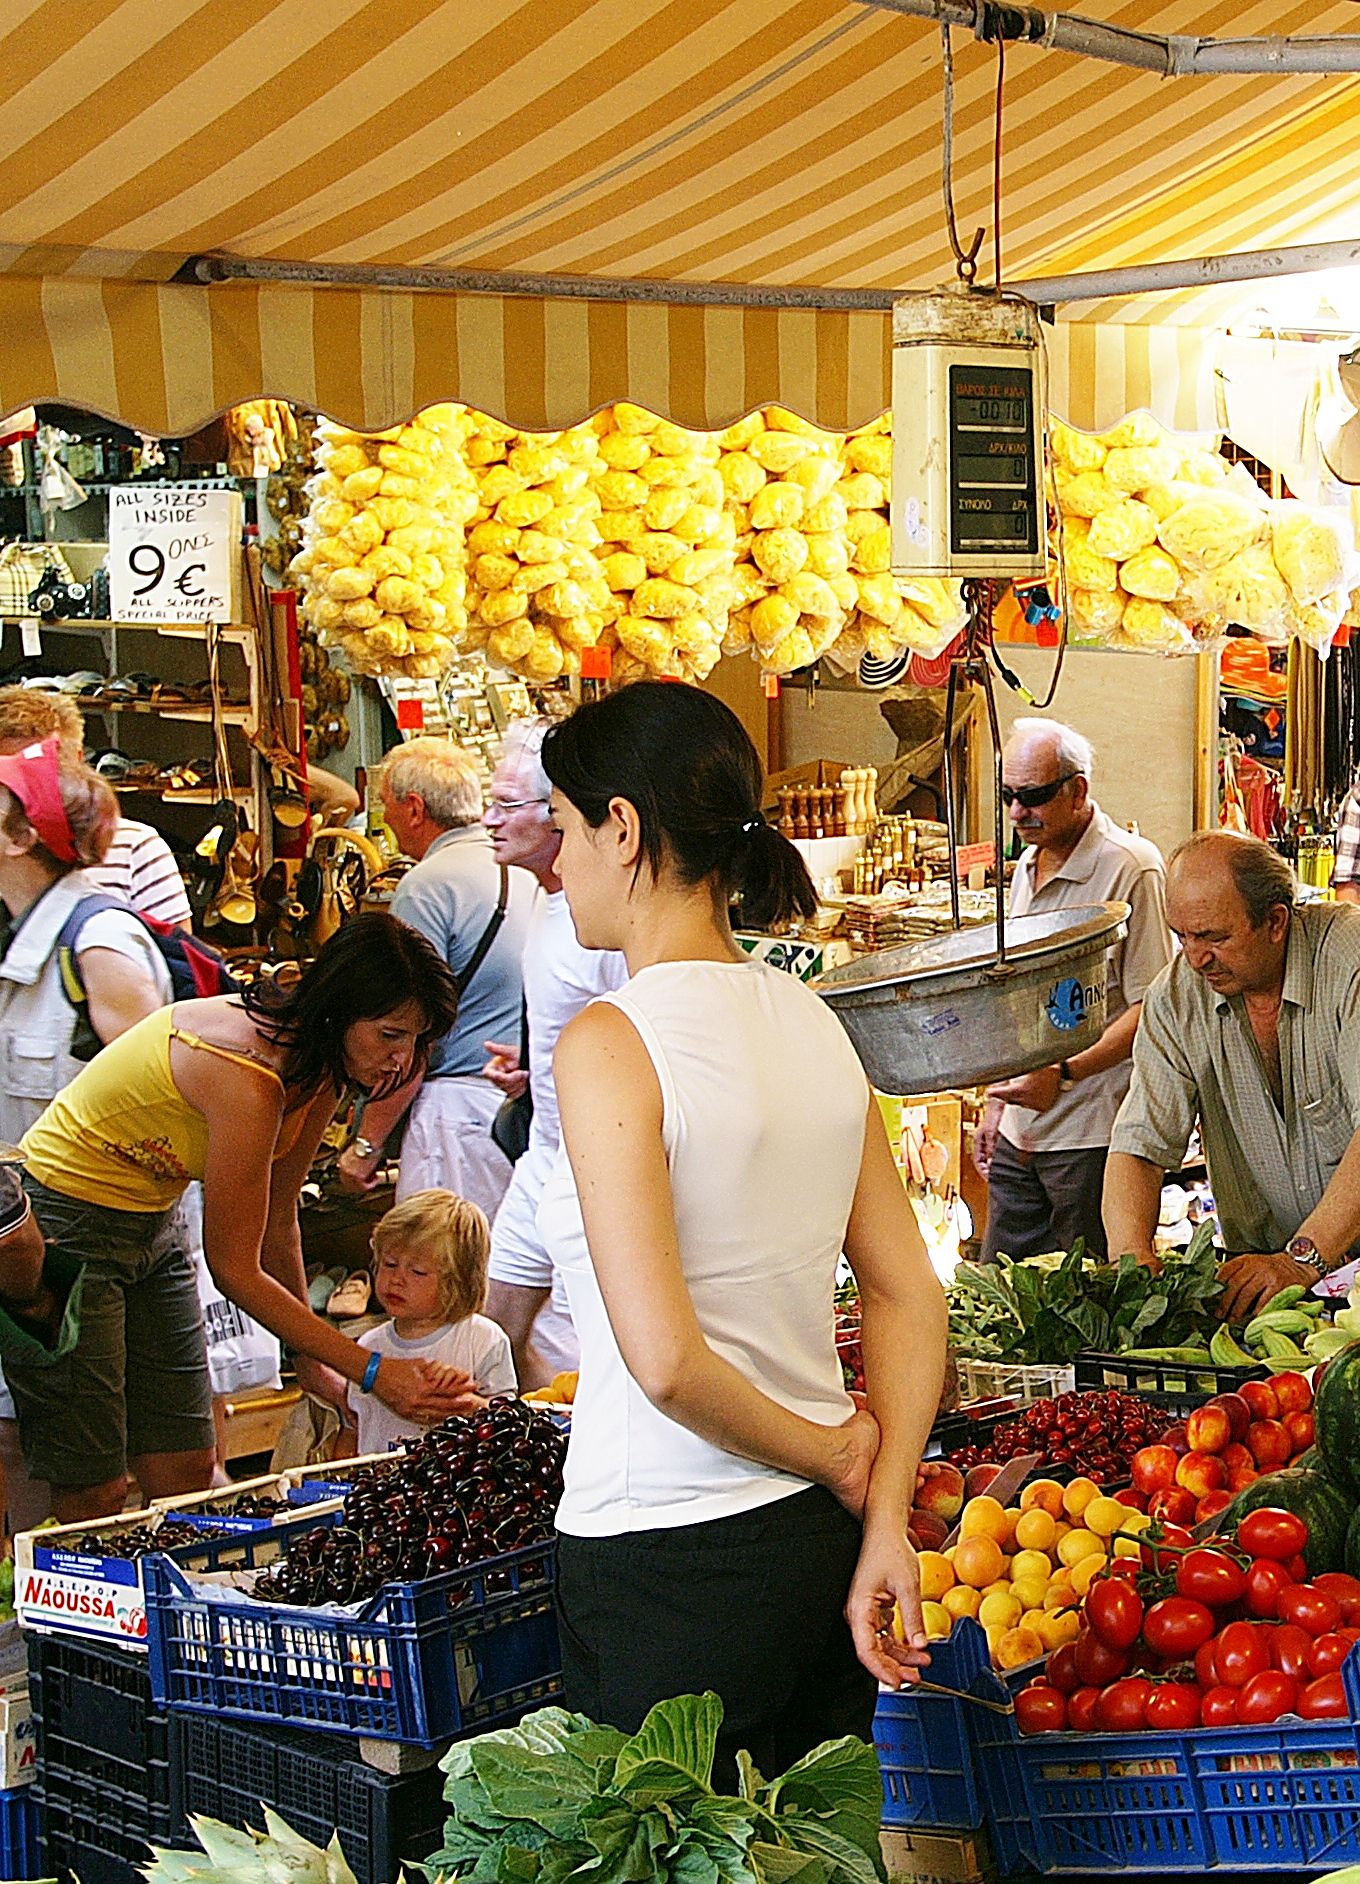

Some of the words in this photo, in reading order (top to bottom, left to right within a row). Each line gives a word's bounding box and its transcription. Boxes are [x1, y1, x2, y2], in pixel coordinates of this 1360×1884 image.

[116, 492, 144, 507] ALL
[153, 492, 207, 509] SIZES
[135, 508, 198, 525] INSIDE
[128, 545, 166, 597] 9
[131, 598, 152, 607] ALL
[165, 595, 225, 608] SLIPPERS
[118, 609, 168, 621] SPECIAL
[176, 610, 215, 622] PRICE
[23, 1576, 116, 1619] NAOUSSA
